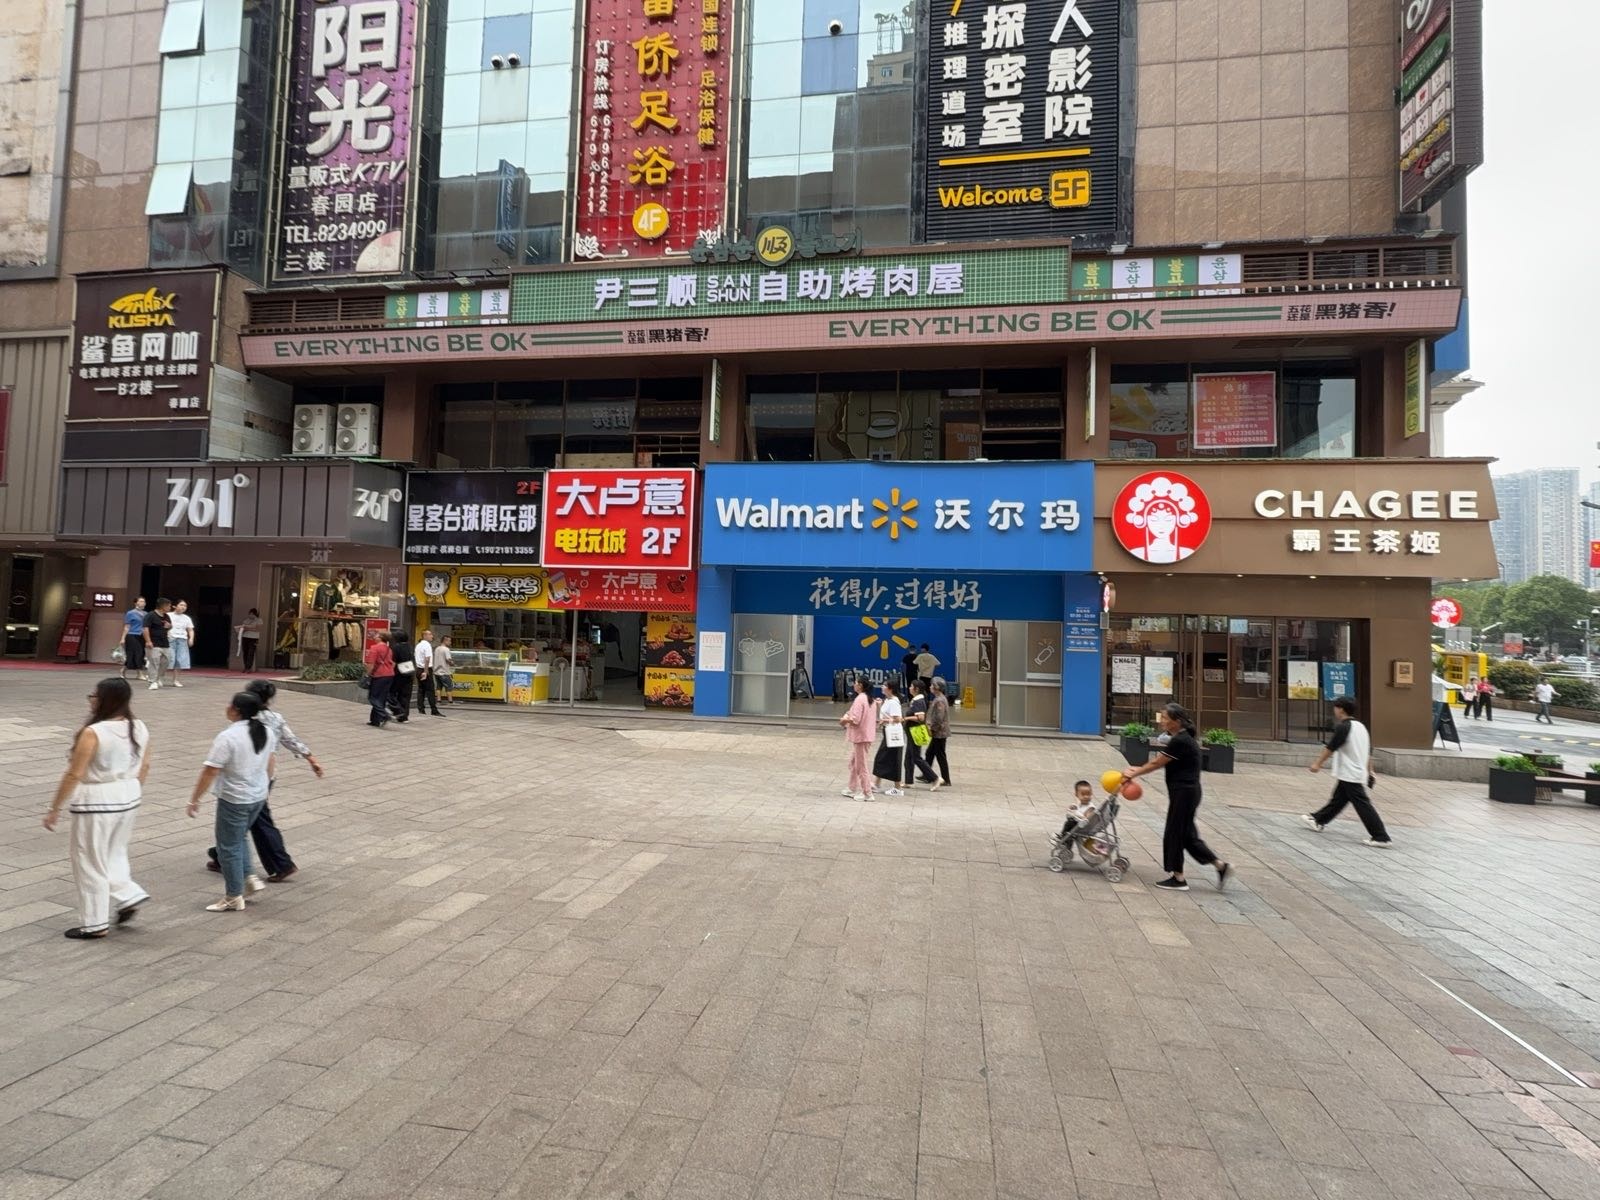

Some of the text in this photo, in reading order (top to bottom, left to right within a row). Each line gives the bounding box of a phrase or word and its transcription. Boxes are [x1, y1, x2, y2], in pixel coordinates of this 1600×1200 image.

[305, 1, 400, 157] 阳光
[592, 39, 610, 110] 订房热线
[942, 21, 968, 148] 推理道场
[979, 3, 1027, 146] 探密室
[697, 70, 717, 146] 足浴保健
[310, 191, 379, 216] 春园店
[938, 184, 1043, 208] Welcome
[637, 208, 662, 231] 4F
[284, 251, 327, 272] 三楼
[594, 262, 964, 310] 尹三顺 SAN SHUN 自助烤肉屋
[829, 308, 1156, 338] EVERYTHING BE OK
[81, 331, 200, 364] 鲨鱼网咖
[274, 332, 529, 357] EVERYTHING BE OK
[516, 480, 542, 495] 2F
[555, 477, 686, 516] 大卢意
[407, 503, 537, 533] 星客台球俱乐部
[715, 497, 1081, 532] Walmart 沃尔玛
[1255, 489, 1479, 521] CHAGEE
[555, 527, 682, 555] 电玩城 2F
[1291, 529, 1441, 554] 霸王茶姬
[459, 576, 538, 595] 周黑鸭
[601, 572, 658, 589] 大卢意
